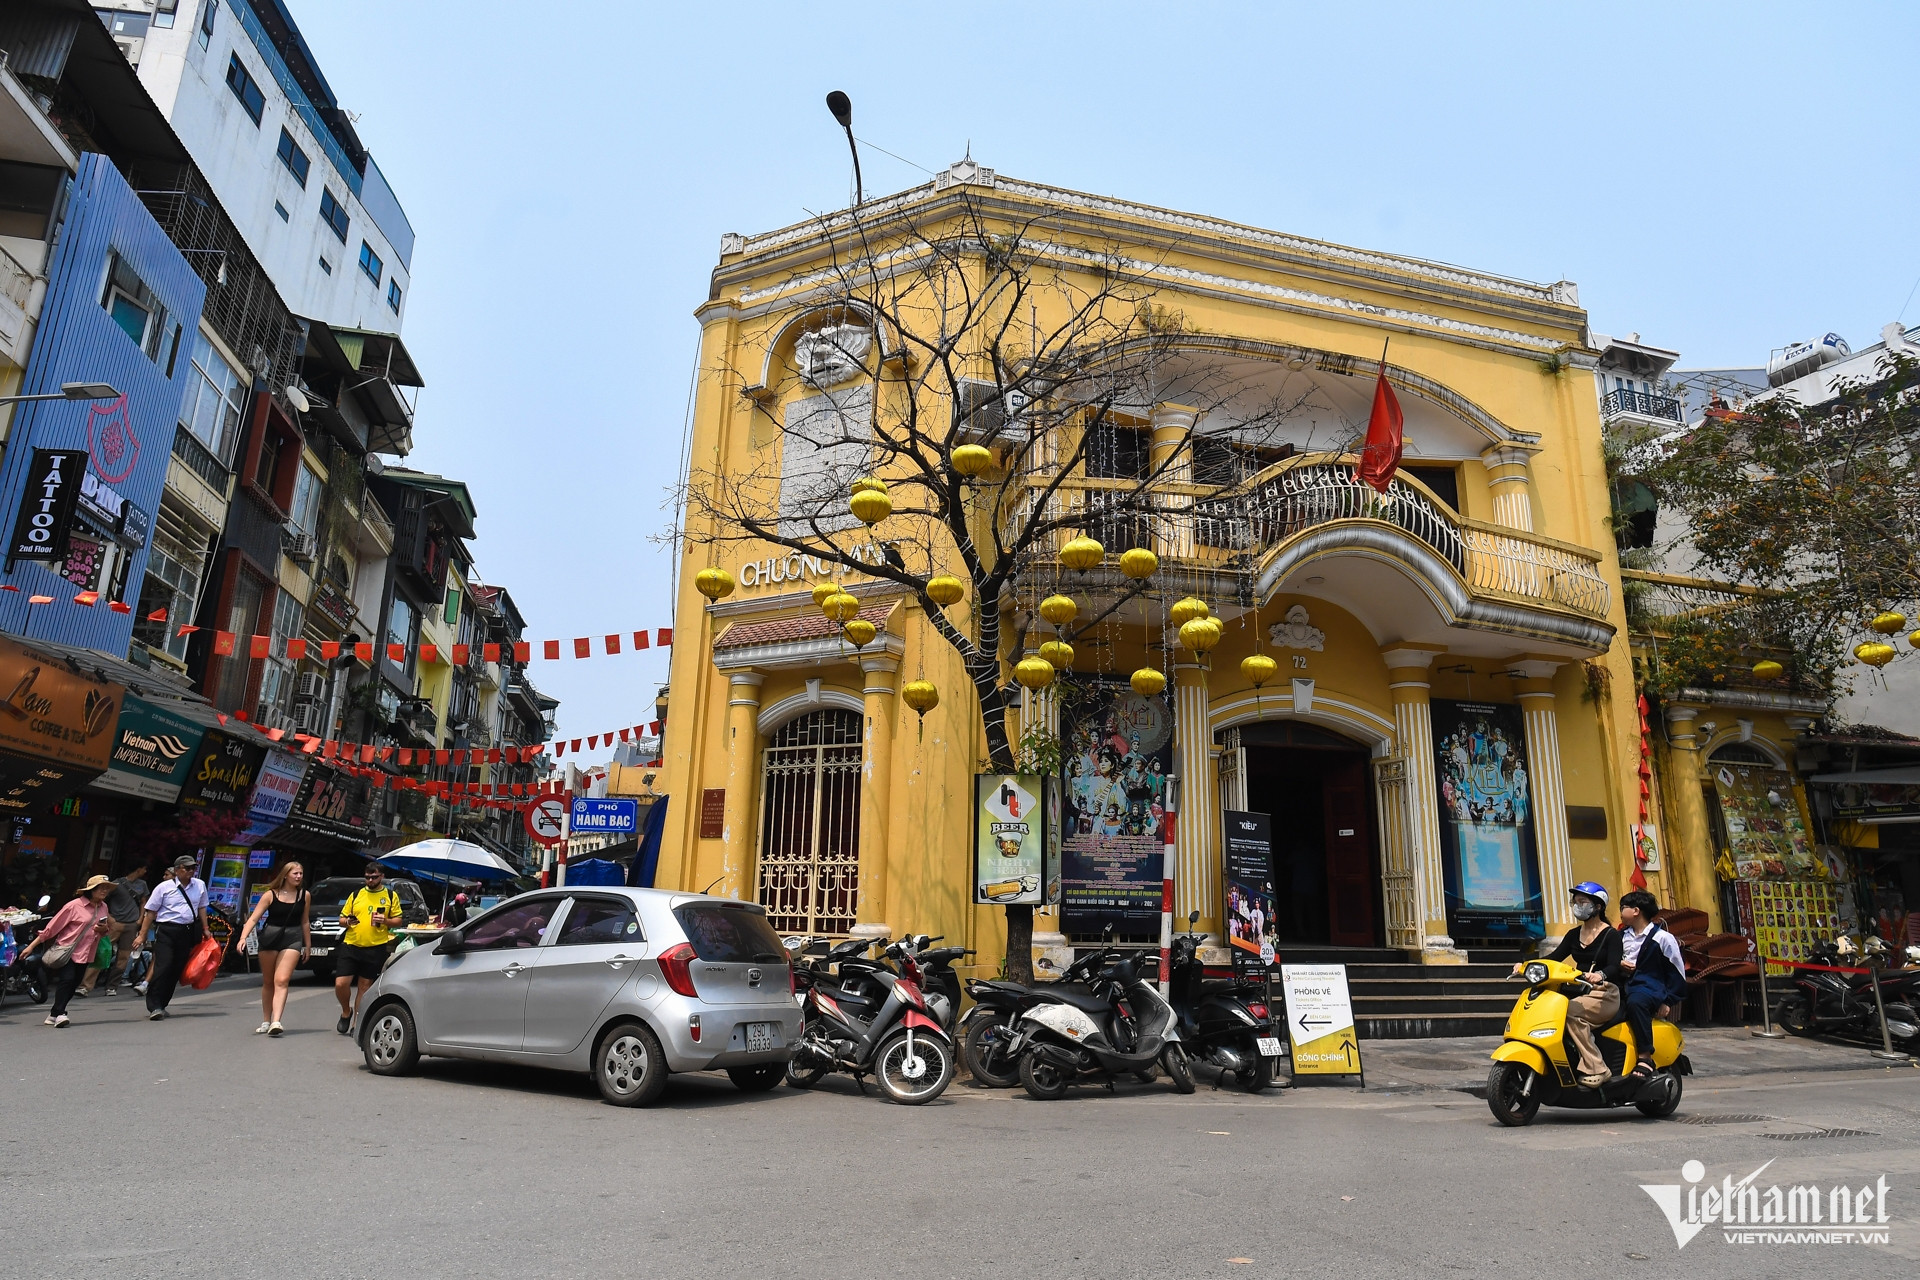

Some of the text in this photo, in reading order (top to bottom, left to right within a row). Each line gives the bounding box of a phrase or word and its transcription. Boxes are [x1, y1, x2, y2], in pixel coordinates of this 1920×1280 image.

[28, 455, 67, 542] TATTOO
[128, 505, 148, 528] TATTOO
[123, 524, 145, 546] PIERCING
[19, 544, 53, 553] 2nd Floor
[1293, 655, 1307, 669] 72
[30, 718, 63, 738] COFFEE
[122, 729, 157, 753] Vietnam
[113, 746, 160, 770] IMPRESSIVE
[157, 762, 176, 774] travel
[198, 754, 224, 785] Spa
[229, 762, 253, 791] Nail
[201, 787, 217, 801] Beauty
[598, 801, 618, 811] PHỐ
[576, 810, 631, 830] HÀNG BẠC
[992, 823, 1029, 834] BEER
[987, 859, 1033, 867] NIGHT
[992, 866, 1027, 875] BEER
[368, 905, 374, 915] 9
[1294, 986, 1320, 995] PHÒNG
[753, 1024, 766, 1037] 29D
[748, 1038, 771, 1052] 033.33
[1320, 1052, 1345, 1061] CHÍNH
